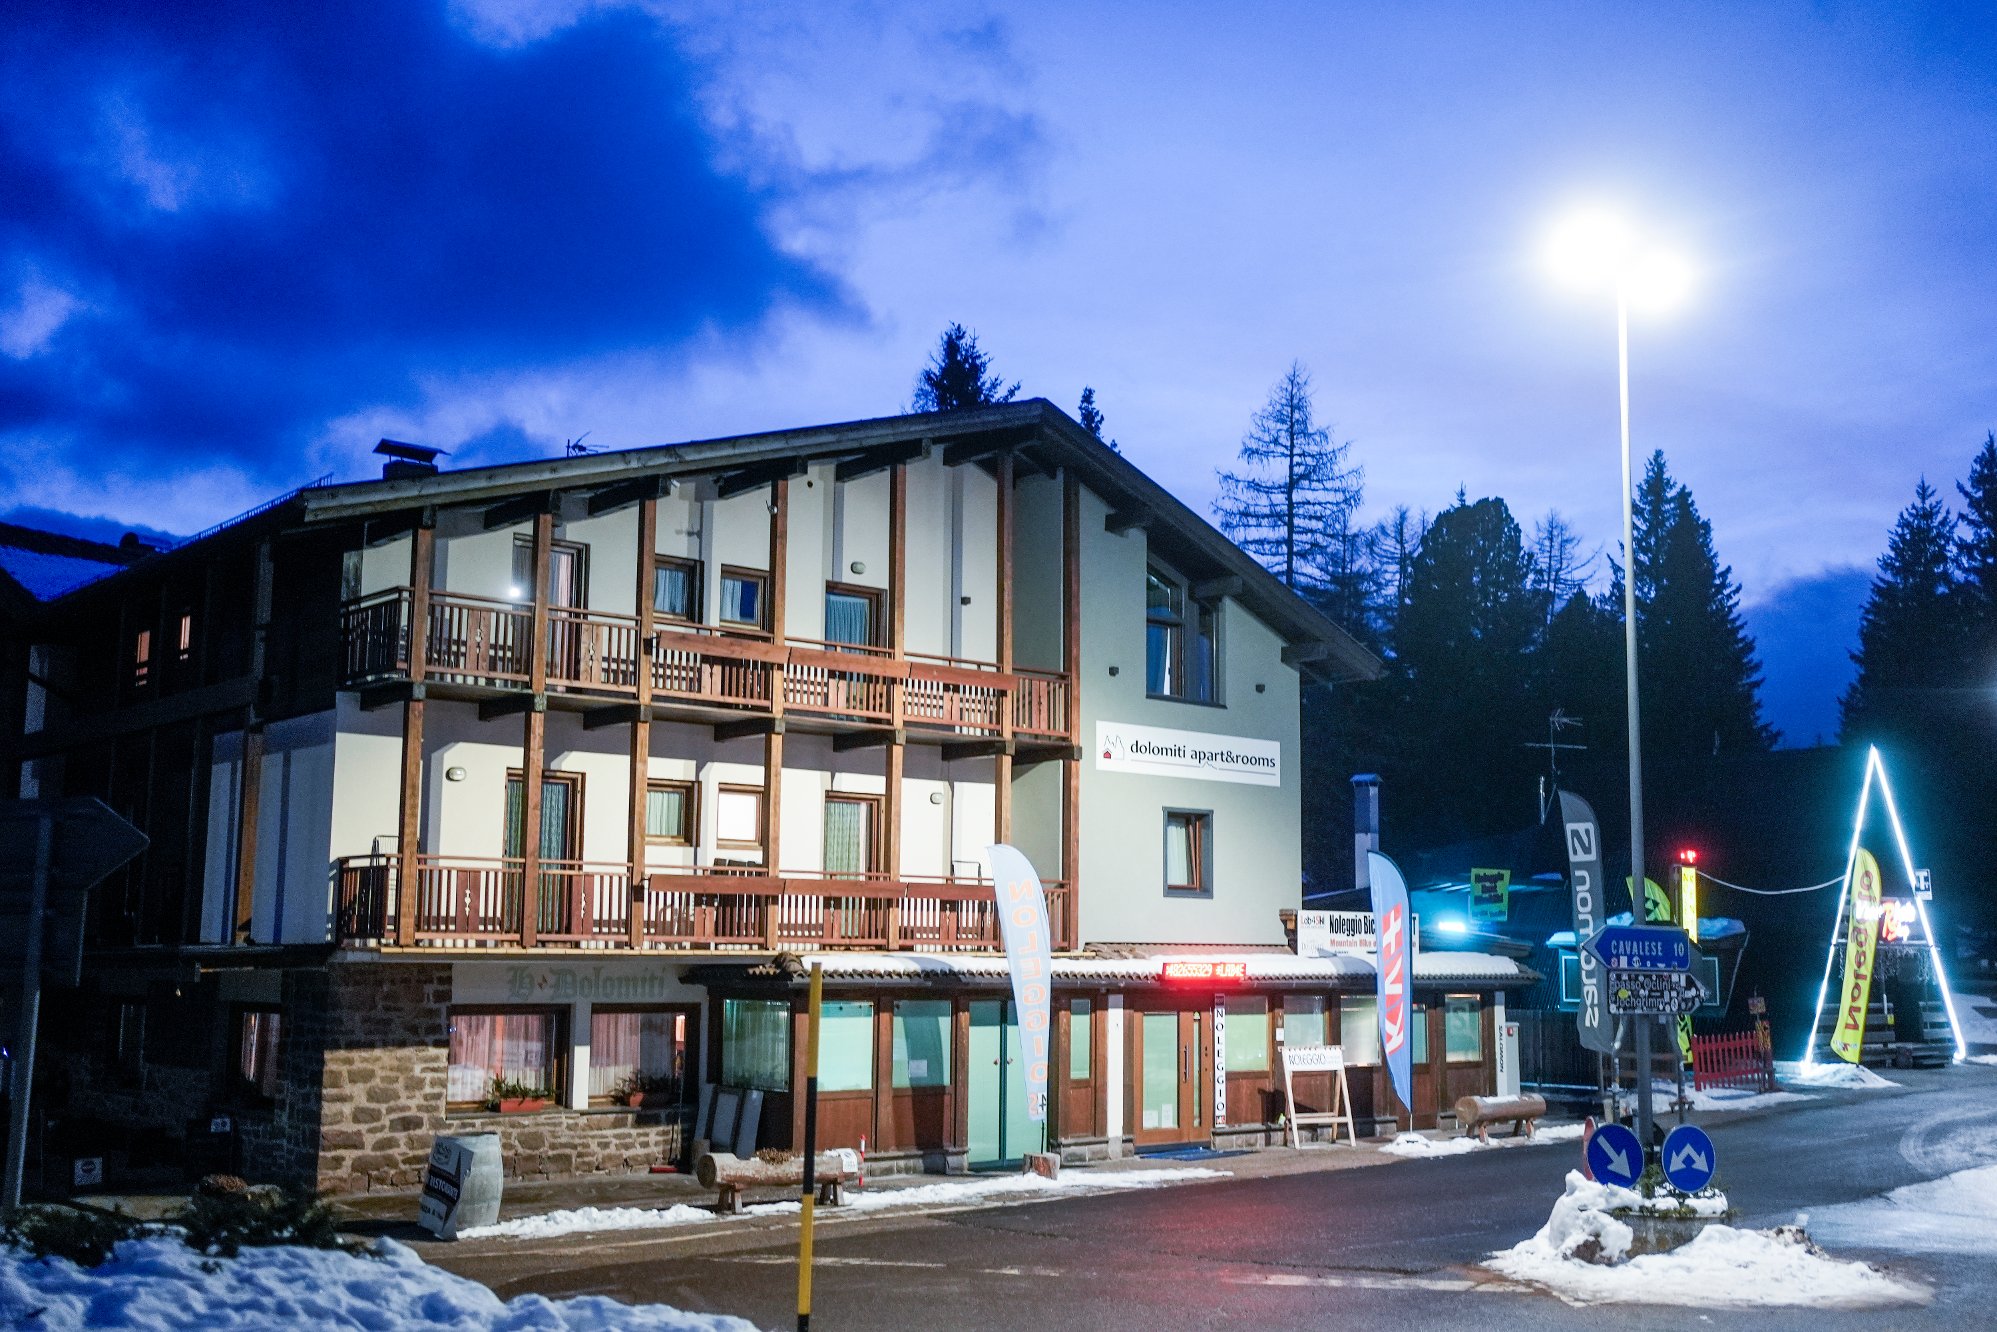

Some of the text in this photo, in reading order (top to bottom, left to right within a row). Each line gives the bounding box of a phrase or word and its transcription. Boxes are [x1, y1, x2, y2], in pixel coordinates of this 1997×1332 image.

[1130, 740, 1276, 768] dolomiti apart&rooms
[1329, 914, 1376, 936] Noleggio Bic
[1330, 938, 1358, 948] Mountain
[1611, 940, 1685, 957] CAVALESE 10
[551, 966, 666, 1000] Dolomiti
[1644, 977, 1671, 992] Oclini
[1215, 1009, 1225, 1112] NOLEGGIO
[1288, 1053, 1326, 1066] NOLEGGIO
